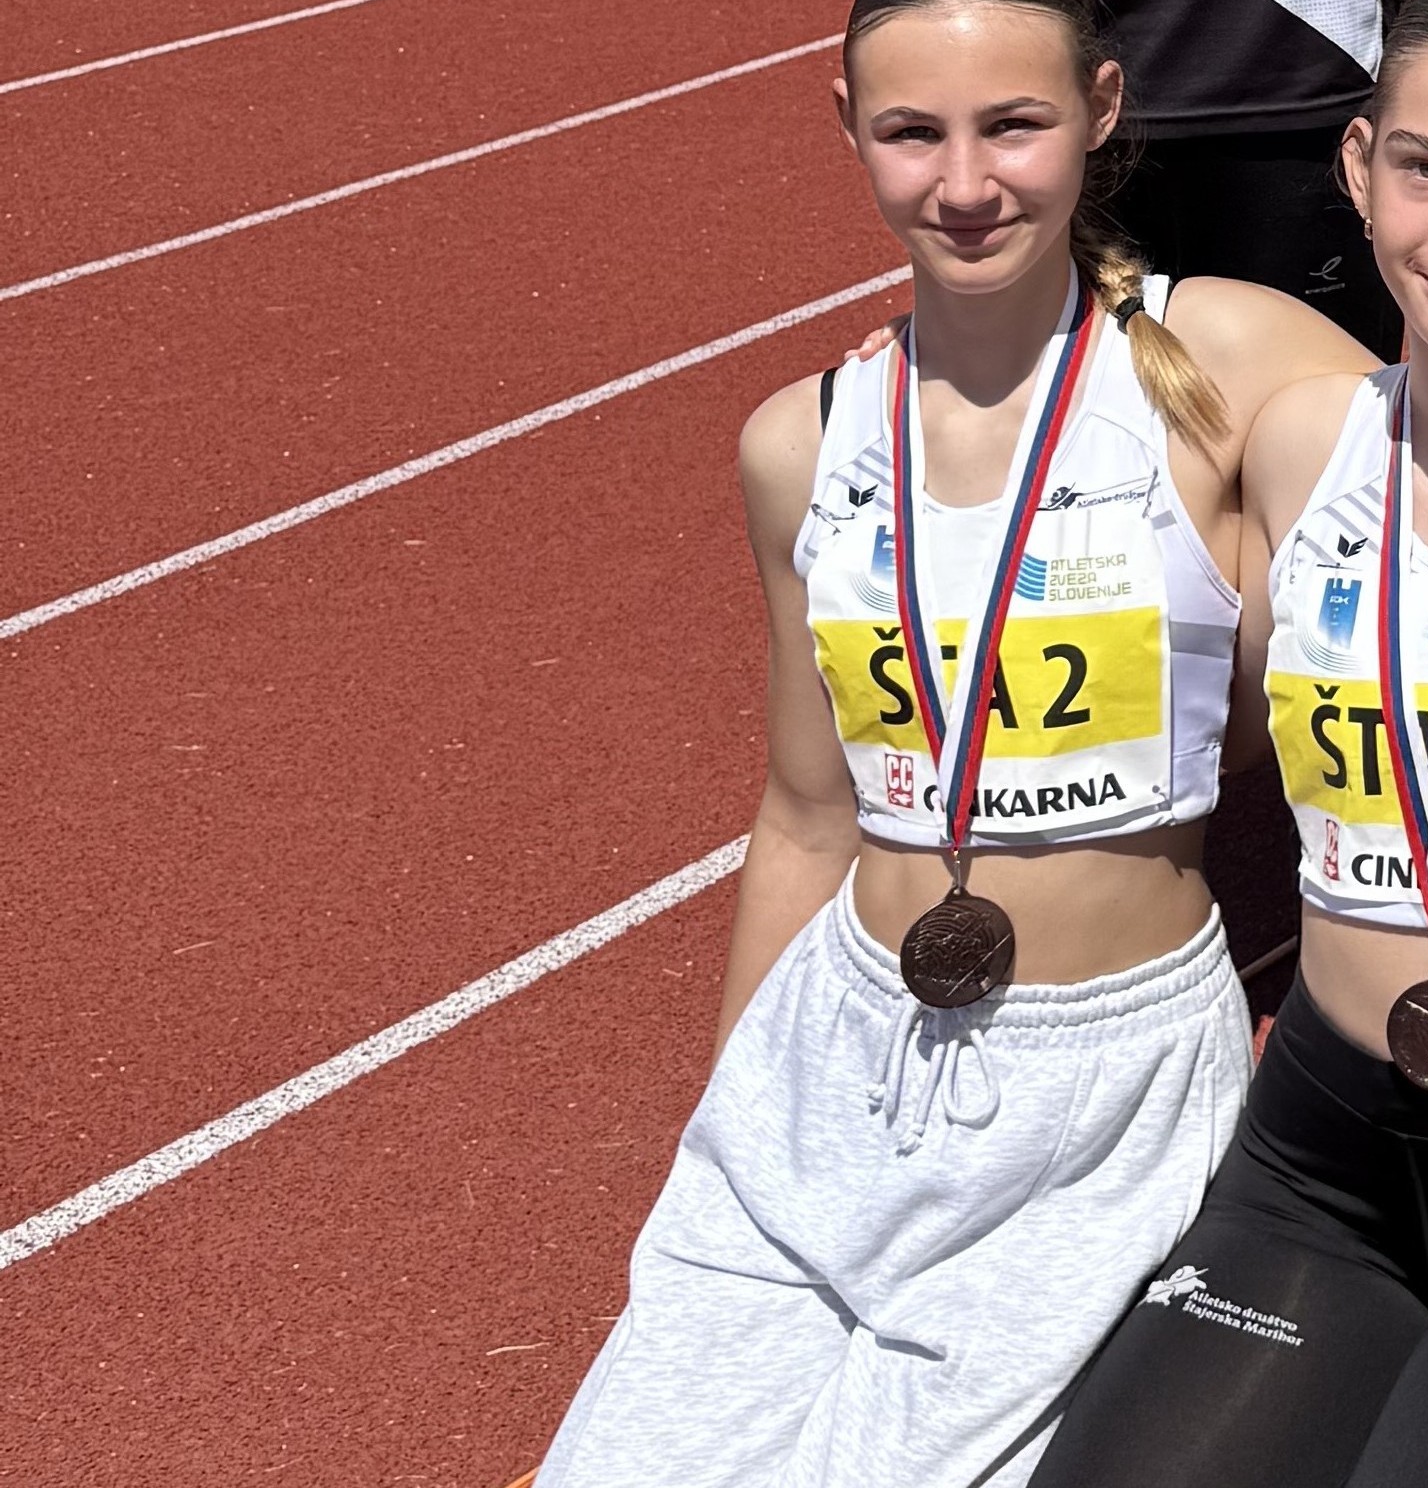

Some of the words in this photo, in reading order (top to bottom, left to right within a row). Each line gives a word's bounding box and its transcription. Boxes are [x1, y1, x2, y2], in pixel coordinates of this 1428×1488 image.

[1050, 554, 1127, 571] ATLETSKA
[1049, 573, 1097, 586] ZVEZA
[1049, 581, 1132, 601] SLOVENIJE
[1042, 643, 1090, 729] 2
[1182, 1300, 1241, 1328] Štajerska
[1242, 1320, 1304, 1346] Maribor
[1188, 1291, 1241, 1314] Atletsko
[1242, 1307, 1298, 1331] društvo
